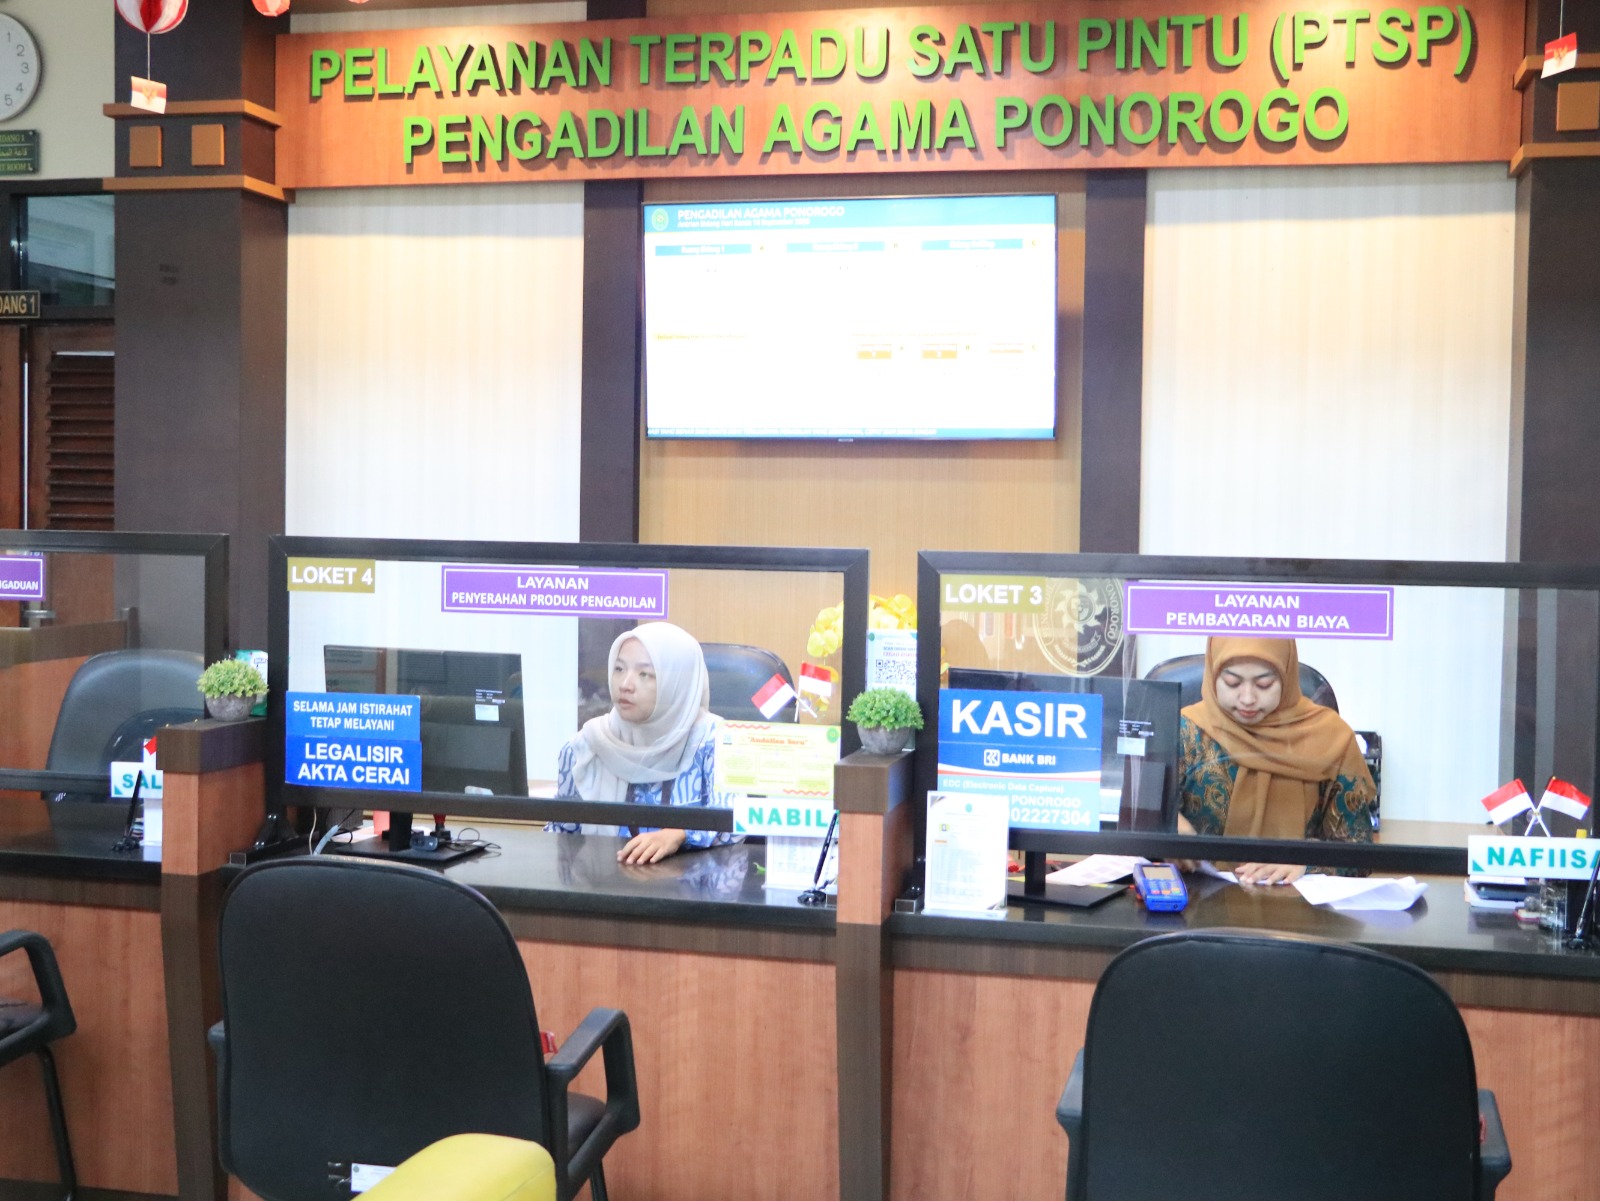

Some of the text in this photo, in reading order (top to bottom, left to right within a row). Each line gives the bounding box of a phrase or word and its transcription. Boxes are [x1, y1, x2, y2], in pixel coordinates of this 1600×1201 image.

[16, 44, 25, 57] 2
[310, 4, 1474, 98] PELAYANAN TERPADU SATU PINTU (PTSP)
[20, 62, 30, 74] 3
[15, 82, 24, 94] 4
[4, 94, 13, 107] 5
[403, 87, 1350, 165] PENGADILAN AGAMA PONOROGO
[677, 205, 845, 221] PENGADILAN AGAMA PONOROGO
[30, 295, 35, 314] 1
[291, 565, 373, 586] LOKET 4
[517, 575, 590, 591] LAYANAN
[451, 591, 657, 610] PENYERAHAN PRODUK PENGADILAN
[944, 583, 1043, 605] LOKET 3
[1214, 593, 1300, 610] LAYANAN
[1166, 612, 1350, 630] PEMBAYARAN BIAYA
[293, 700, 413, 717] SELAMA JAM ISTIRAHAT
[310, 716, 395, 731] TETAP MELAYANI
[951, 699, 1088, 739] KASIR
[304, 743, 404, 764] LEGALISIR
[1002, 753, 1057, 766] BANK BRI
[297, 763, 410, 785] AKTA CERAI
[943, 778, 1065, 795] EDC (Electronic Data Capture)
[1011, 795, 1082, 808] PONOROGO
[748, 806, 840, 828] NABIL
[1010, 808, 1092, 826] 02227304
